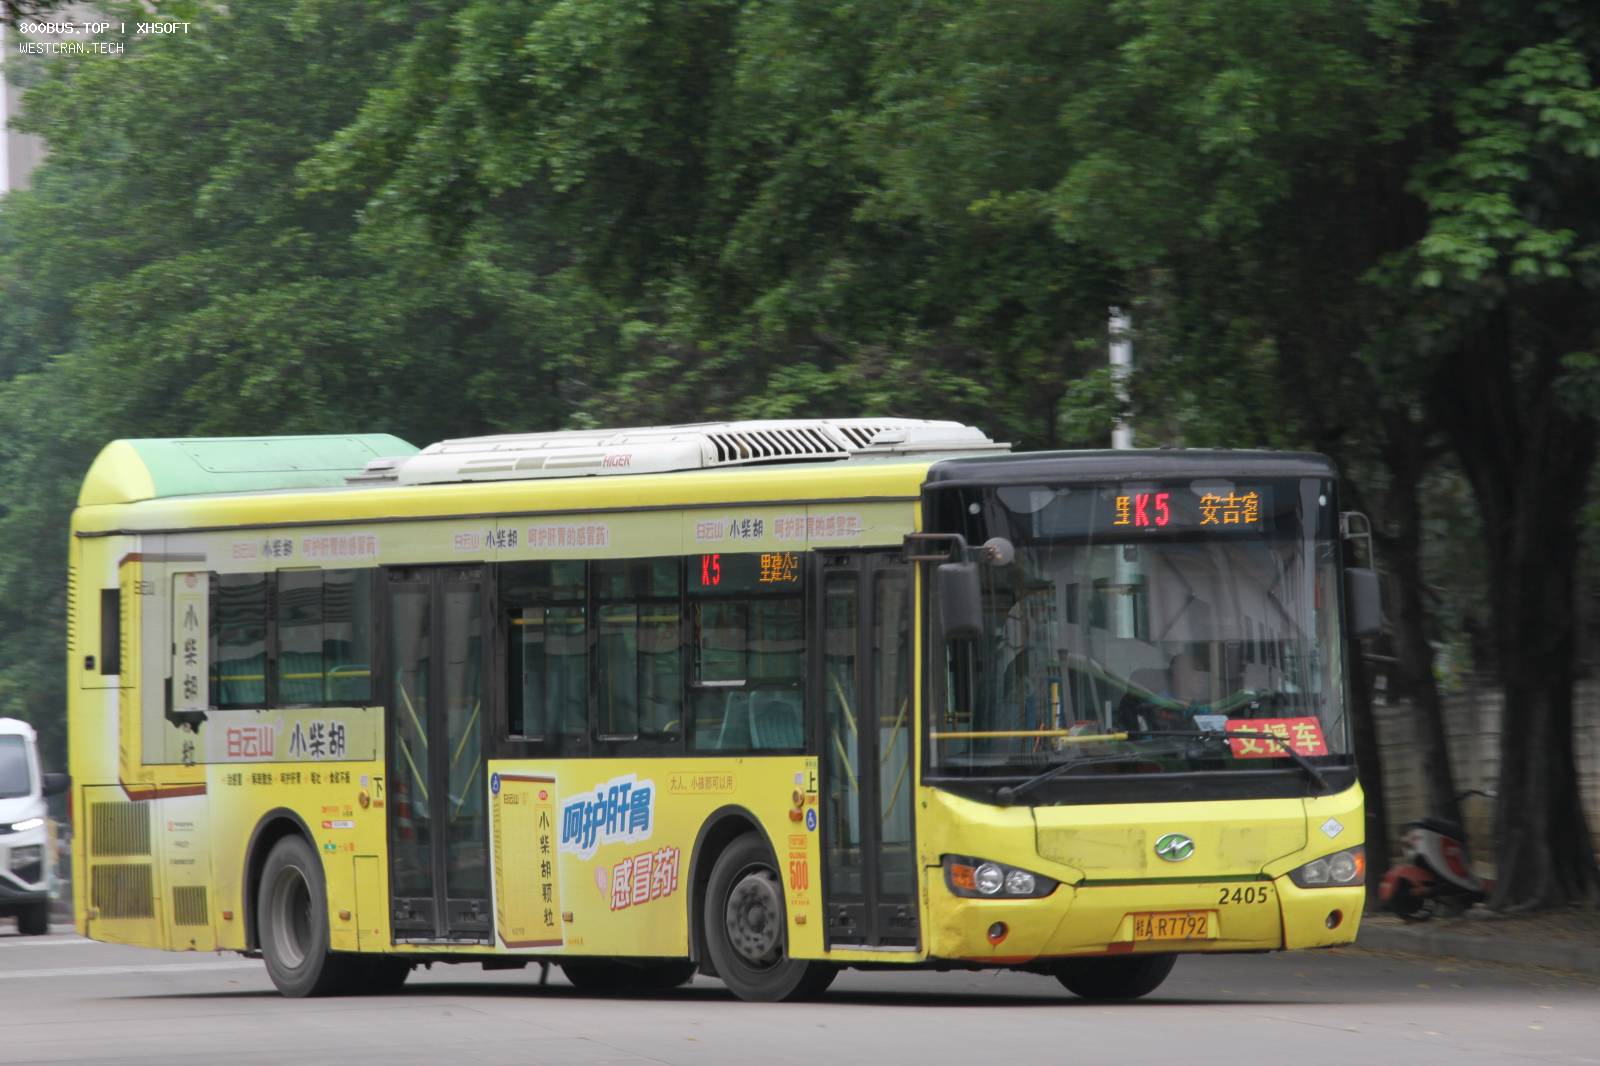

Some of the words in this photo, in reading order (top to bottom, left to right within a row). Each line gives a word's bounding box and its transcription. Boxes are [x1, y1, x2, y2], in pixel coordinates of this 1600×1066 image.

[602, 454, 632, 467] HIGER
[1135, 492, 1169, 527] K5
[485, 529, 518, 549] 小柴胡
[697, 522, 723, 540] 白云山
[730, 518, 763, 540] 小柴胡
[263, 538, 293, 558] 小柴胡
[701, 553, 721, 586] K5
[226, 726, 274, 758] 白云山
[288, 721, 346, 759] 小柴胡
[373, 777, 383, 798] 下
[806, 771, 817, 793] 上
[562, 782, 651, 850] 呵护肝胃
[539, 811, 555, 927] 小柴胡颗粒
[610, 845, 681, 912] 感冒药!
[789, 860, 809, 891] 500
[1218, 887, 1268, 905] 2405
